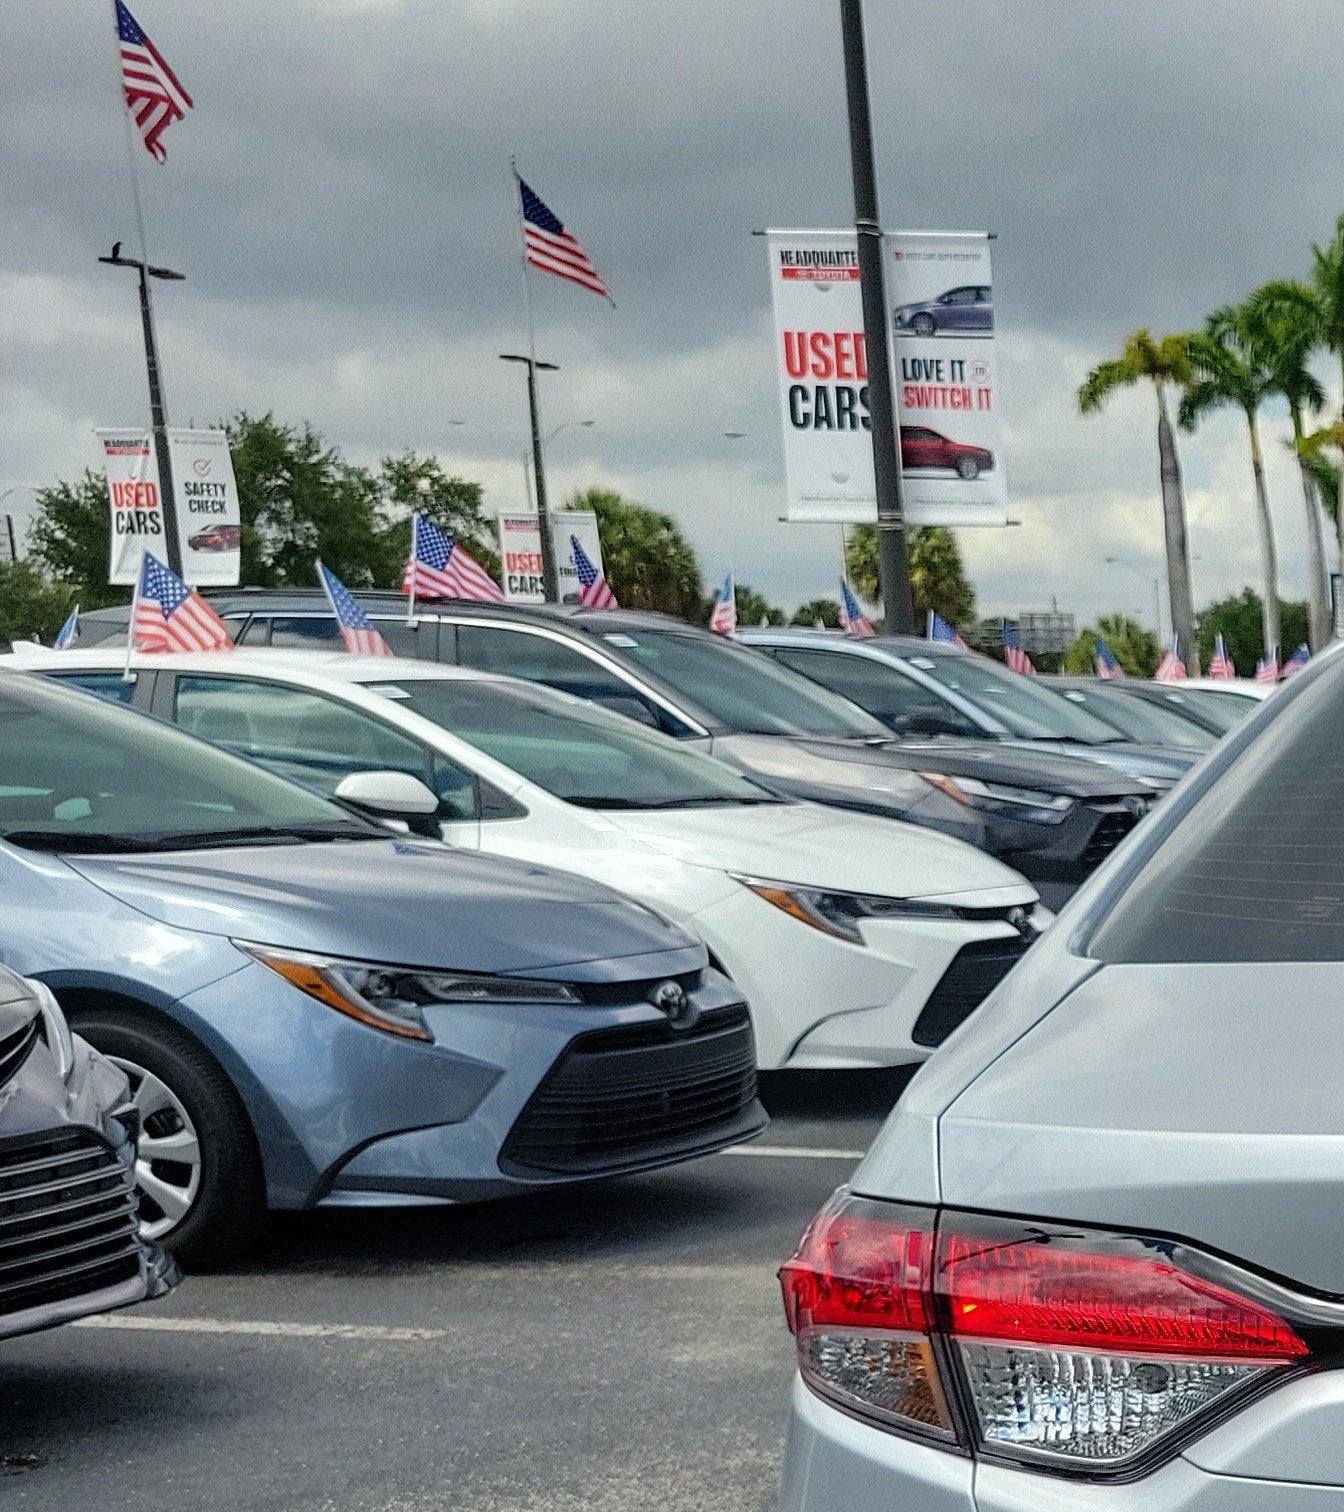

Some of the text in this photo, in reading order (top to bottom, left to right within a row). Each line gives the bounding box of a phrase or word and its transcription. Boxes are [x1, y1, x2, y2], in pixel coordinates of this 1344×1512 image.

[902, 358, 944, 382] LOVE
[951, 359, 966, 384] IT
[904, 386, 992, 412] SWITCH IT
[112, 482, 159, 509] USED
[184, 481, 227, 498] SAFETY
[188, 500, 227, 515] CHECK
[116, 511, 162, 535] CARS
